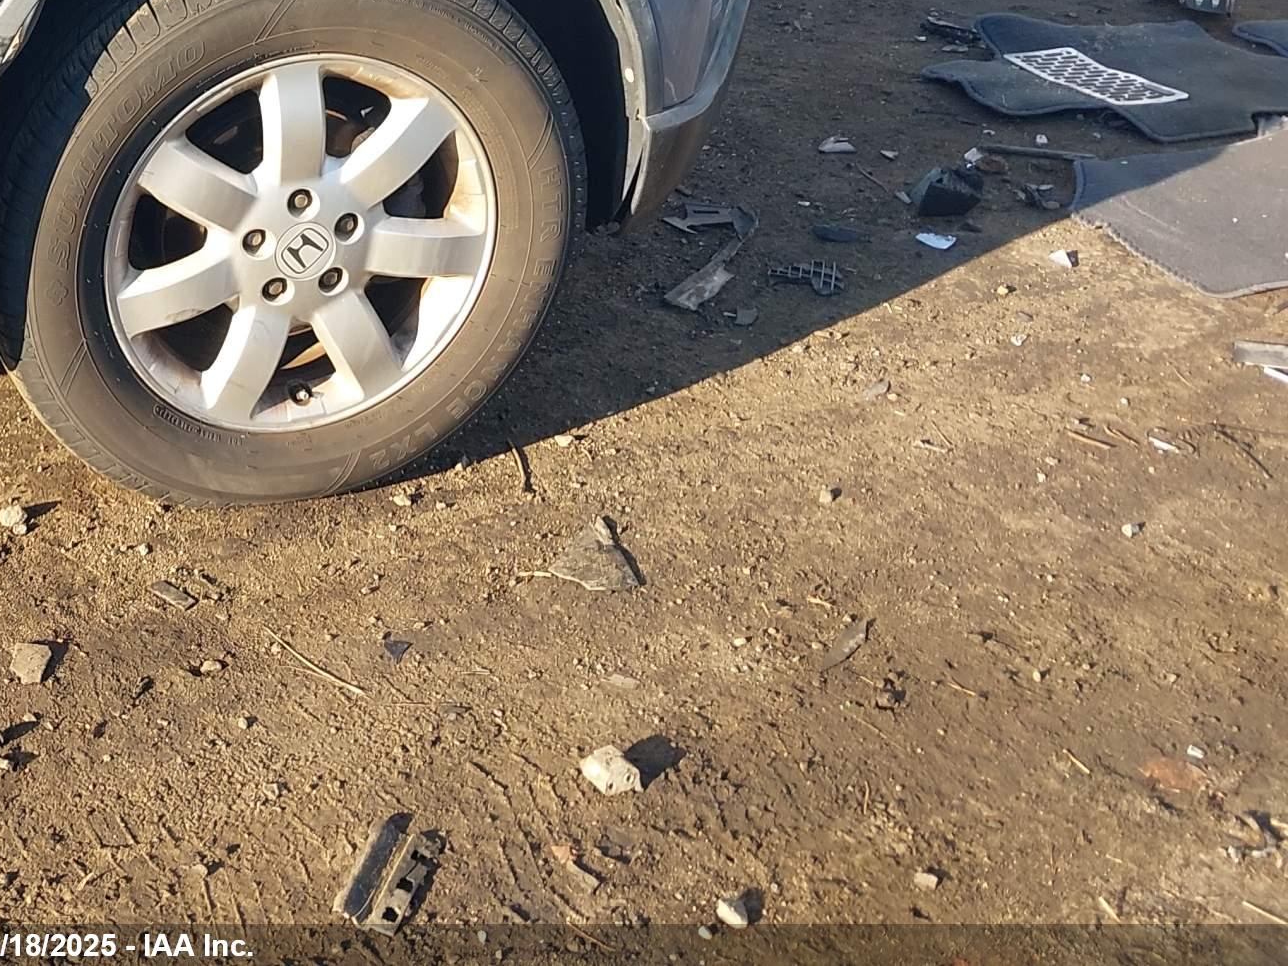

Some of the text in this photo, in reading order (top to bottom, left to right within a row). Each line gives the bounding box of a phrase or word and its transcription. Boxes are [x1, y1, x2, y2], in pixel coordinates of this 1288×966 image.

[47, 40, 206, 268] SUMITOMO
[538, 163, 563, 243] HTR
[445, 257, 558, 420] ENHANCE
[369, 421, 439, 469] LX2
